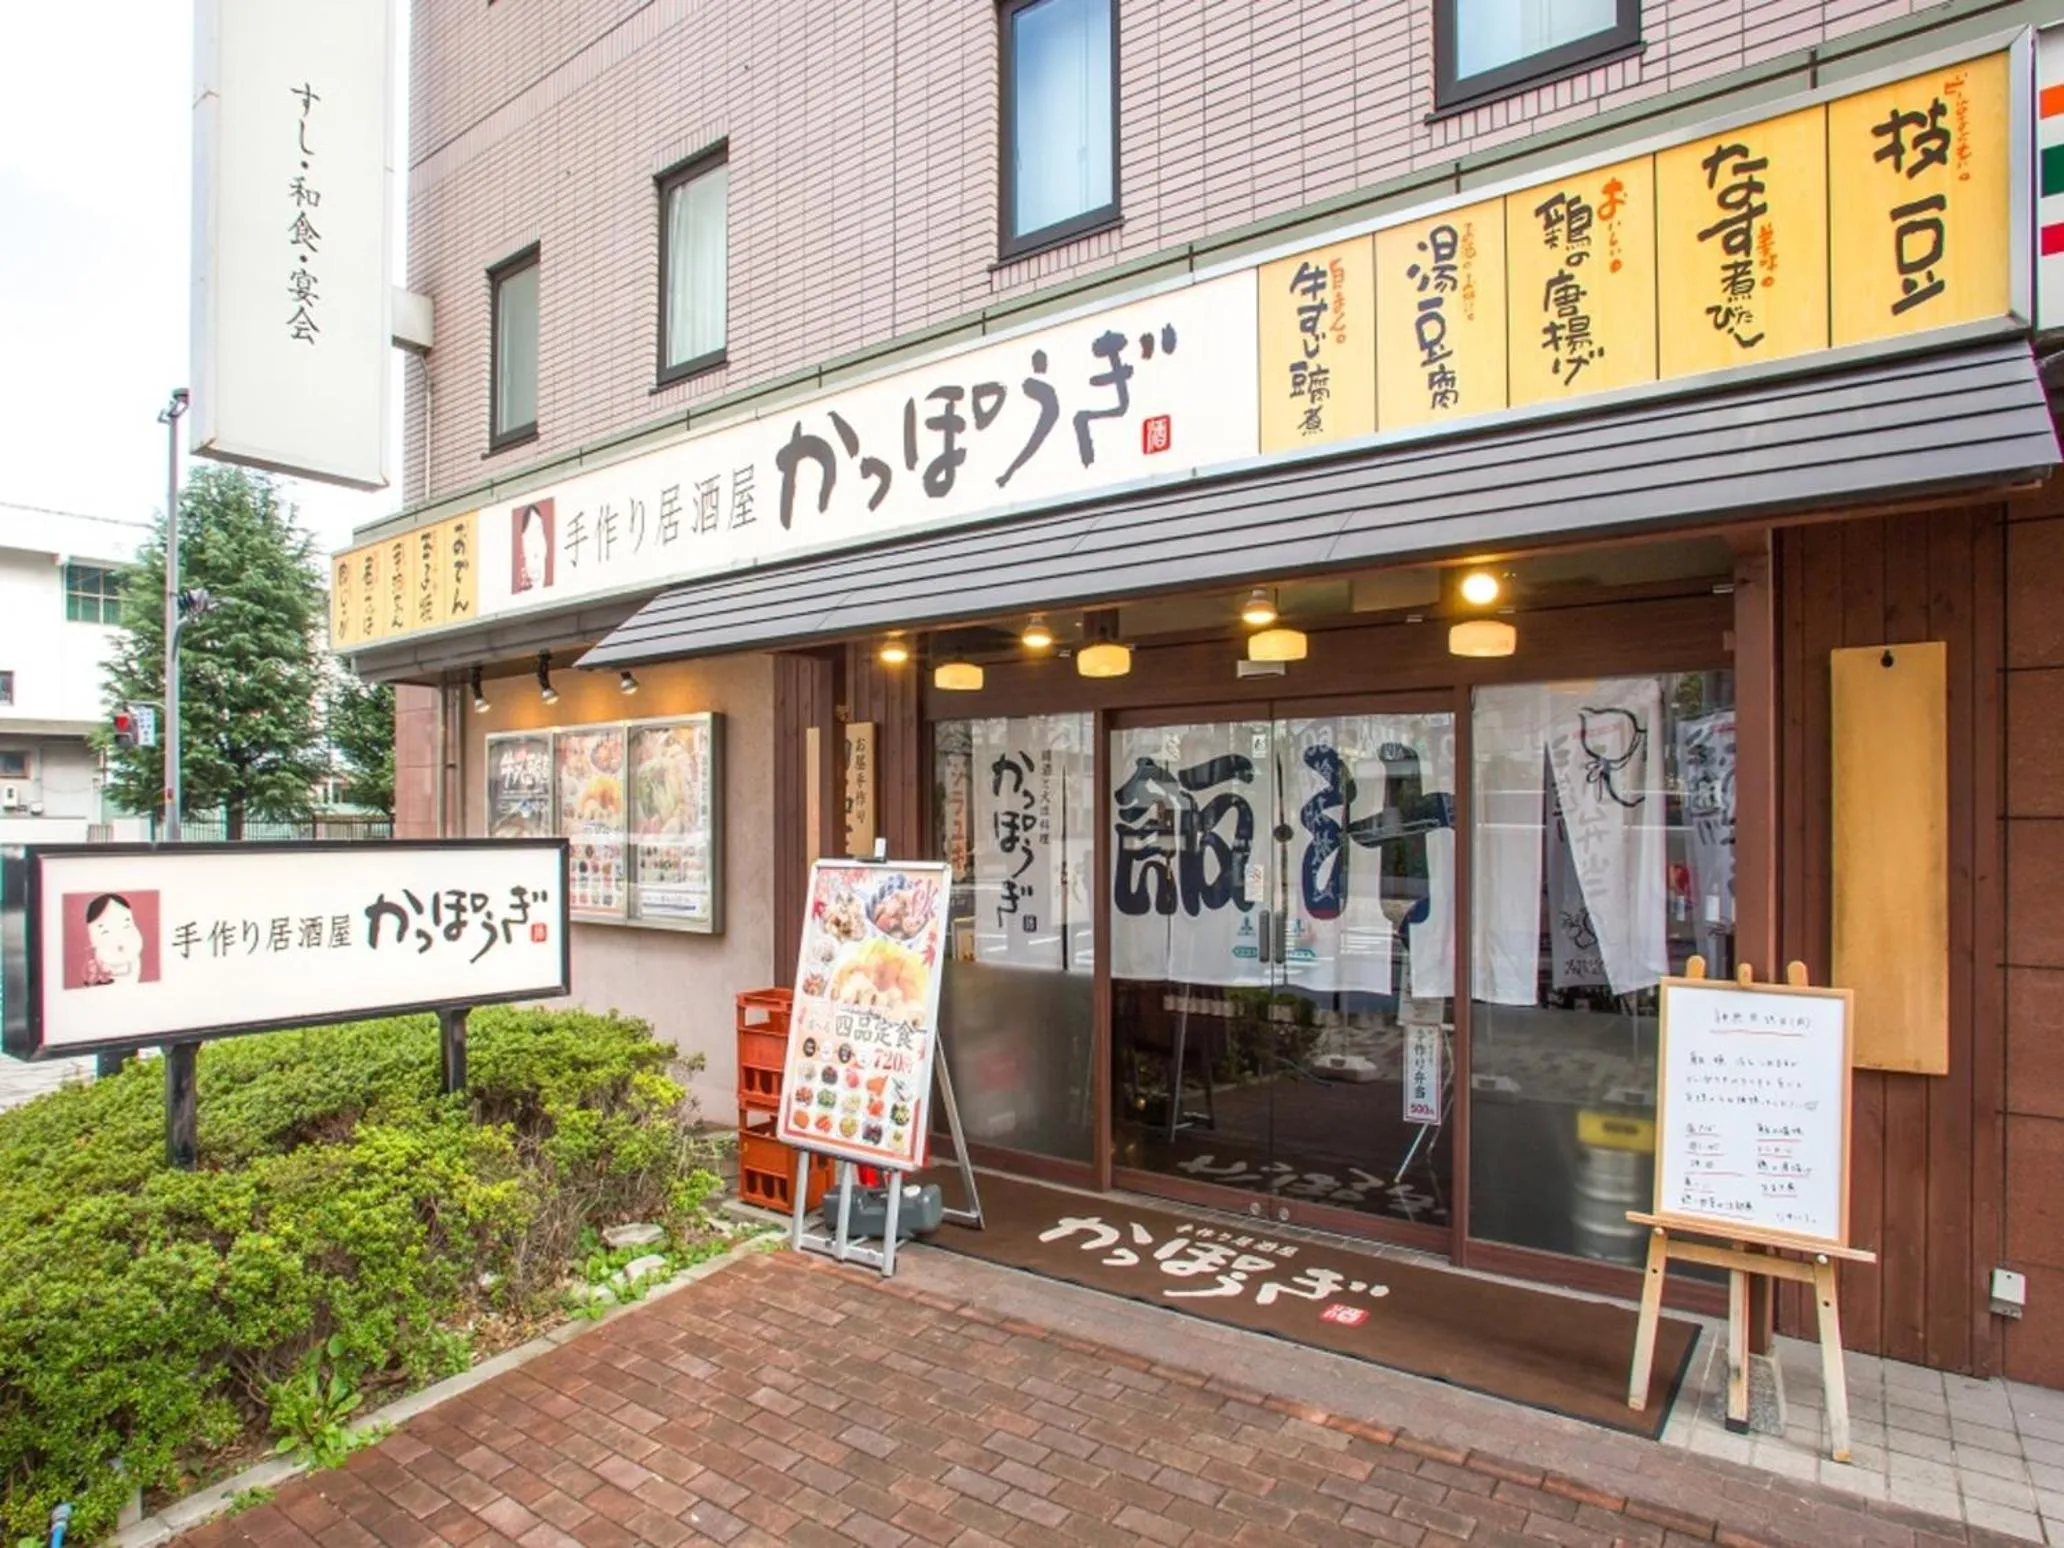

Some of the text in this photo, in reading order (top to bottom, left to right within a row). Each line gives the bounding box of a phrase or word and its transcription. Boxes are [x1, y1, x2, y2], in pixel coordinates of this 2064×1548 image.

[286, 82, 321, 346] すし・和食・宴会
[1534, 192, 1604, 387] 鶏の唐揚げ
[1871, 97, 1951, 317] 枝豆
[1406, 224, 1459, 410] 湯豆腐
[564, 322, 1177, 569] 手作り居酒屋 かっぽうぎ
[172, 885, 548, 964] 手作り居酒屋 かっぽうぎ
[991, 750, 1037, 928] かっぽうぎ
[1038, 1216, 1390, 1305] かっぽうぎ
